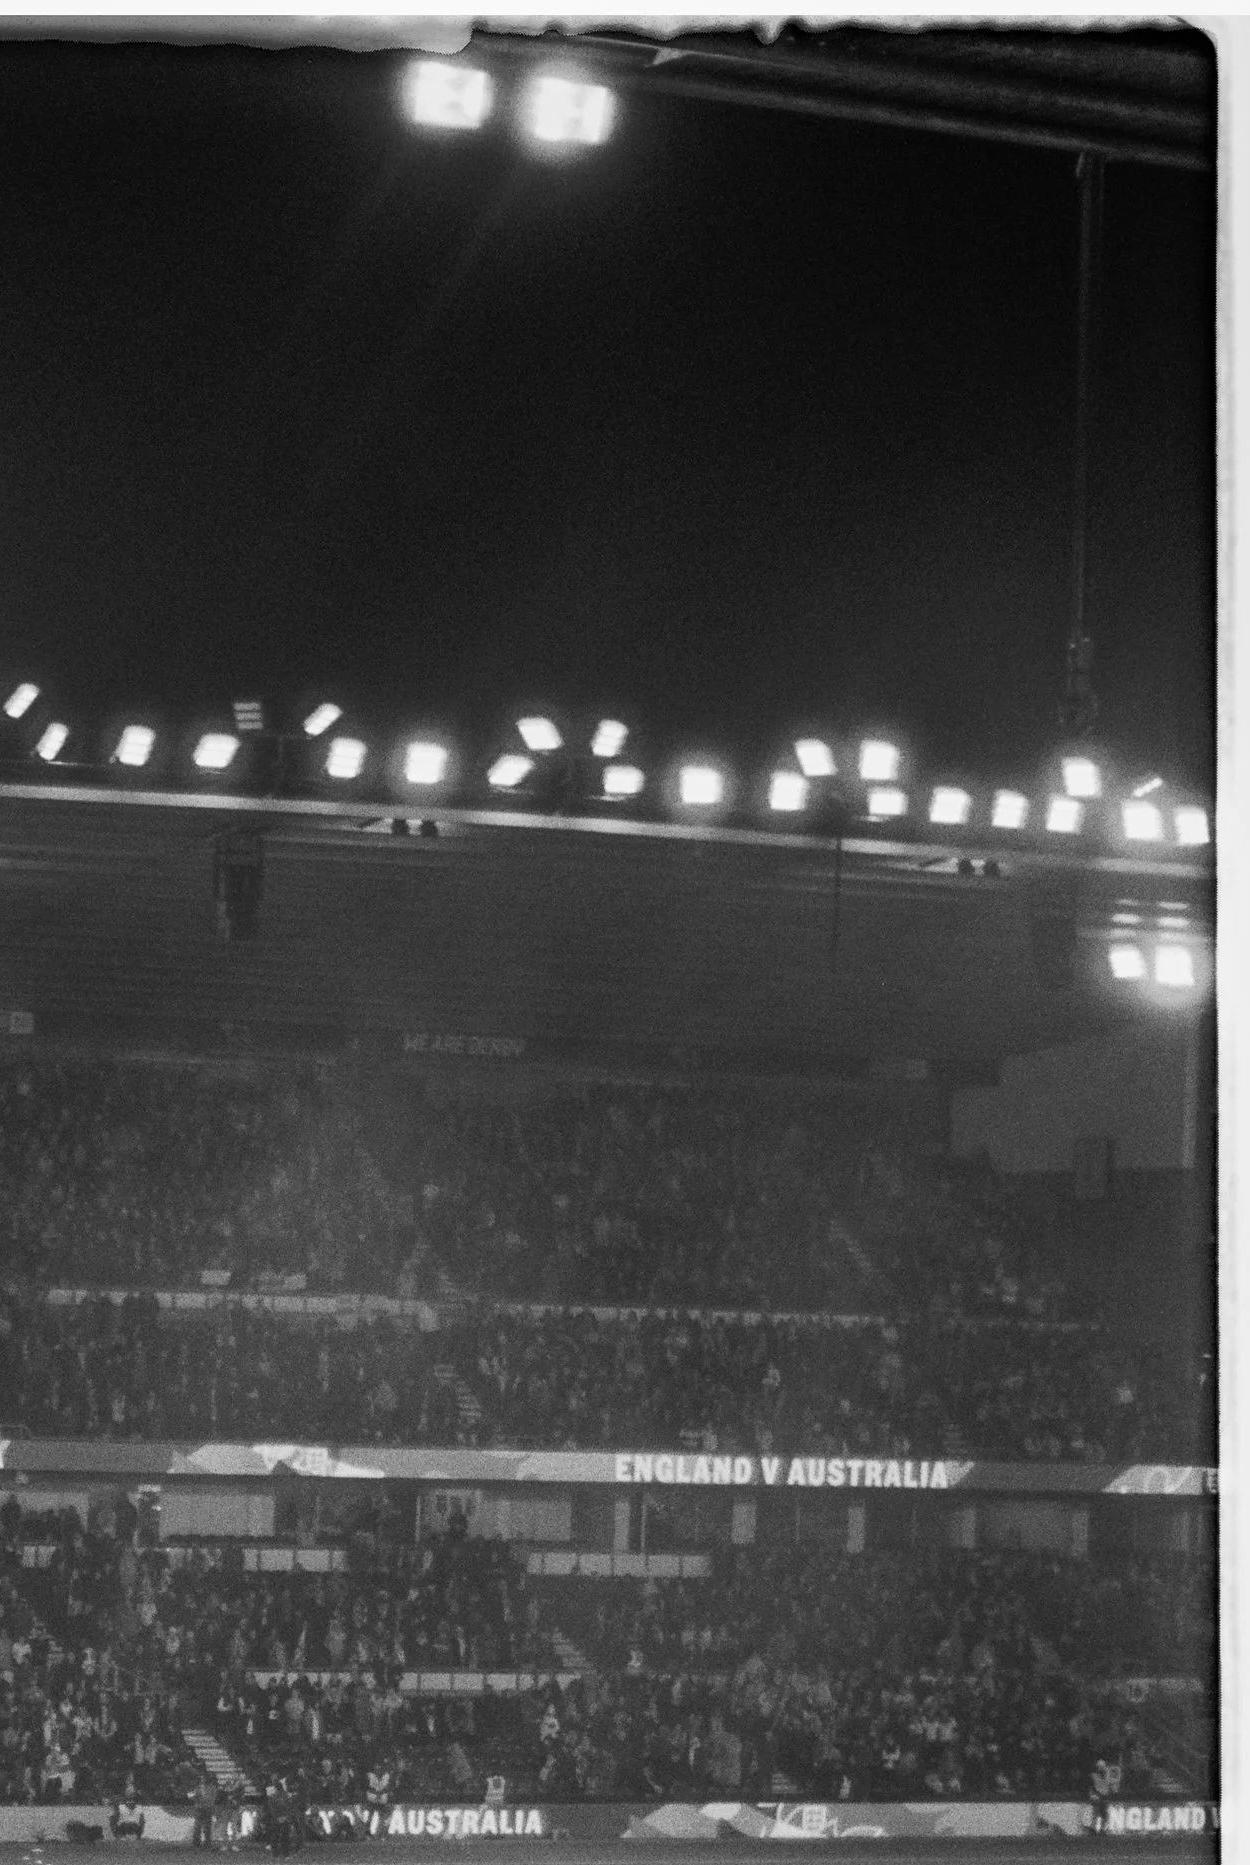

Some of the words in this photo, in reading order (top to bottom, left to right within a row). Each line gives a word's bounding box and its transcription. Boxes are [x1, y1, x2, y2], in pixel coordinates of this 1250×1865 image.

[614, 1454, 751, 1485] ENGLAND
[760, 1456, 779, 1486] V
[786, 1457, 949, 1489] AUSTRALIA
[388, 1808, 543, 1835] AUSTRALIA
[1096, 1805, 1206, 1832] NGLAND
